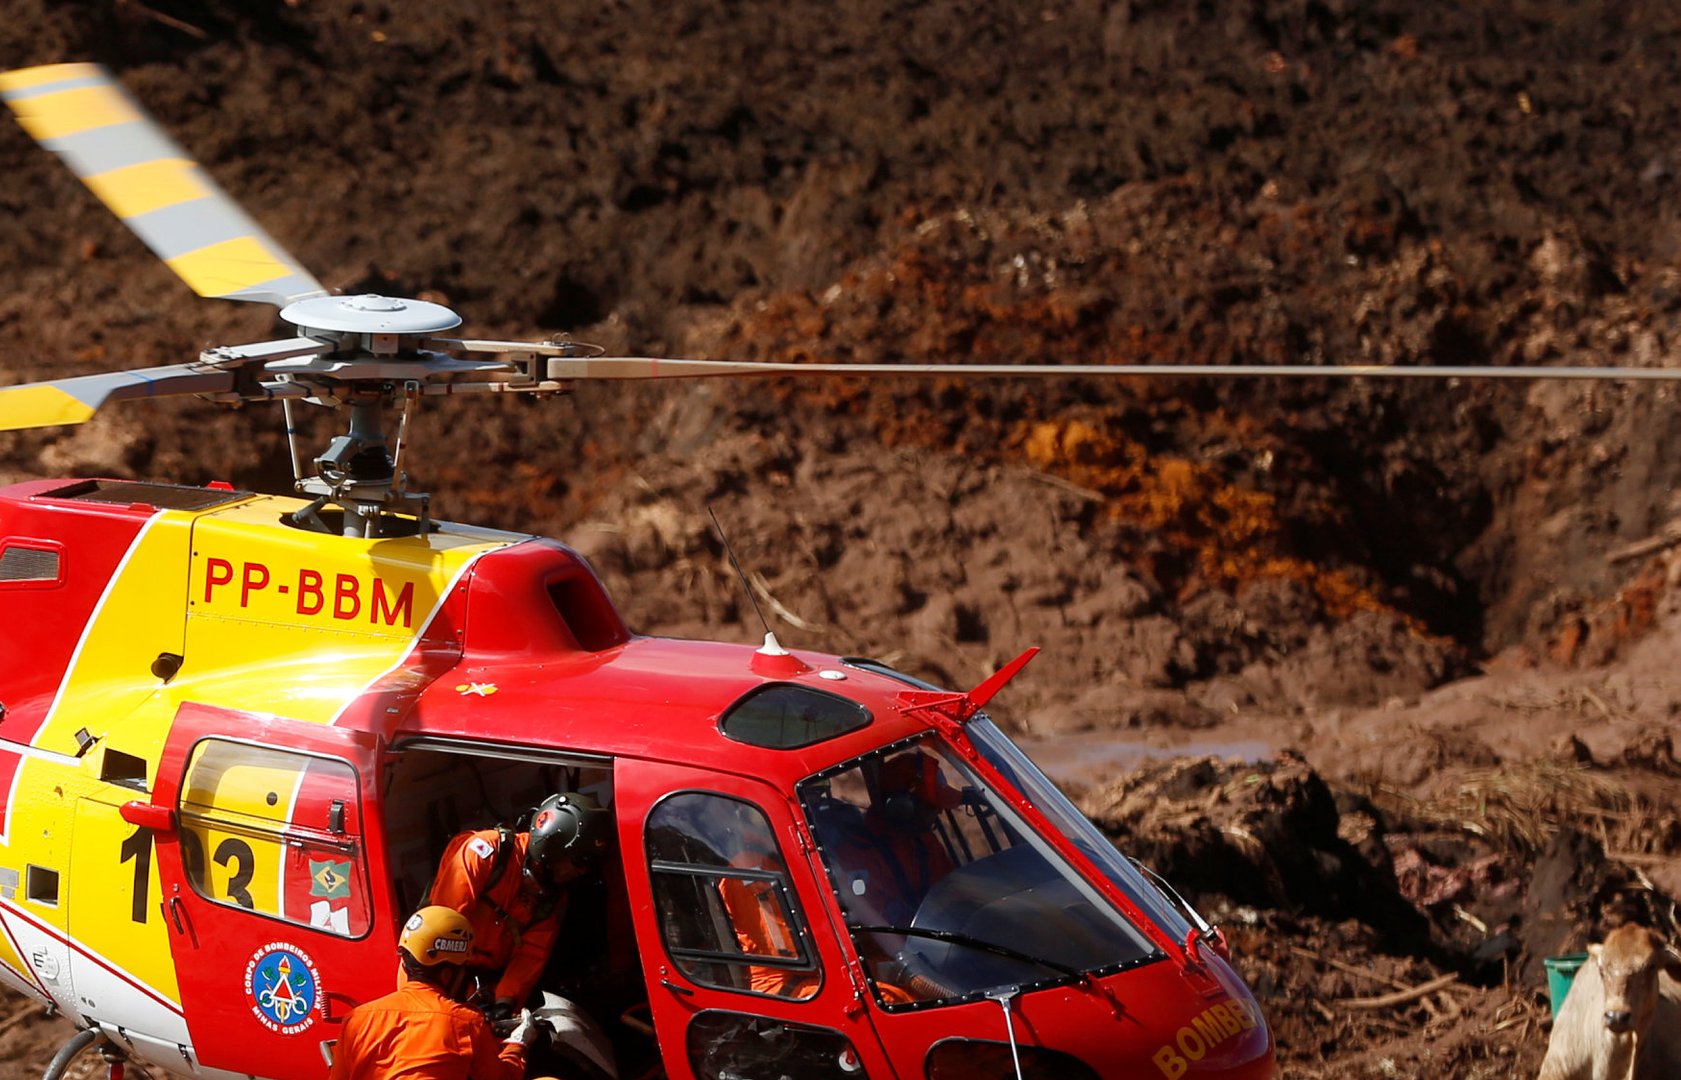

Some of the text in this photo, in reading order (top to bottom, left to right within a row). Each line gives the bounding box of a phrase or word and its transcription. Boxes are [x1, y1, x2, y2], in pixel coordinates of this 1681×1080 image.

[204, 557, 414, 628] PP-BBM
[244, 942, 323, 1010] CORPO DE BOMBEIROS MILITAR
[252, 1005, 314, 1034] MINAS GERAIS
